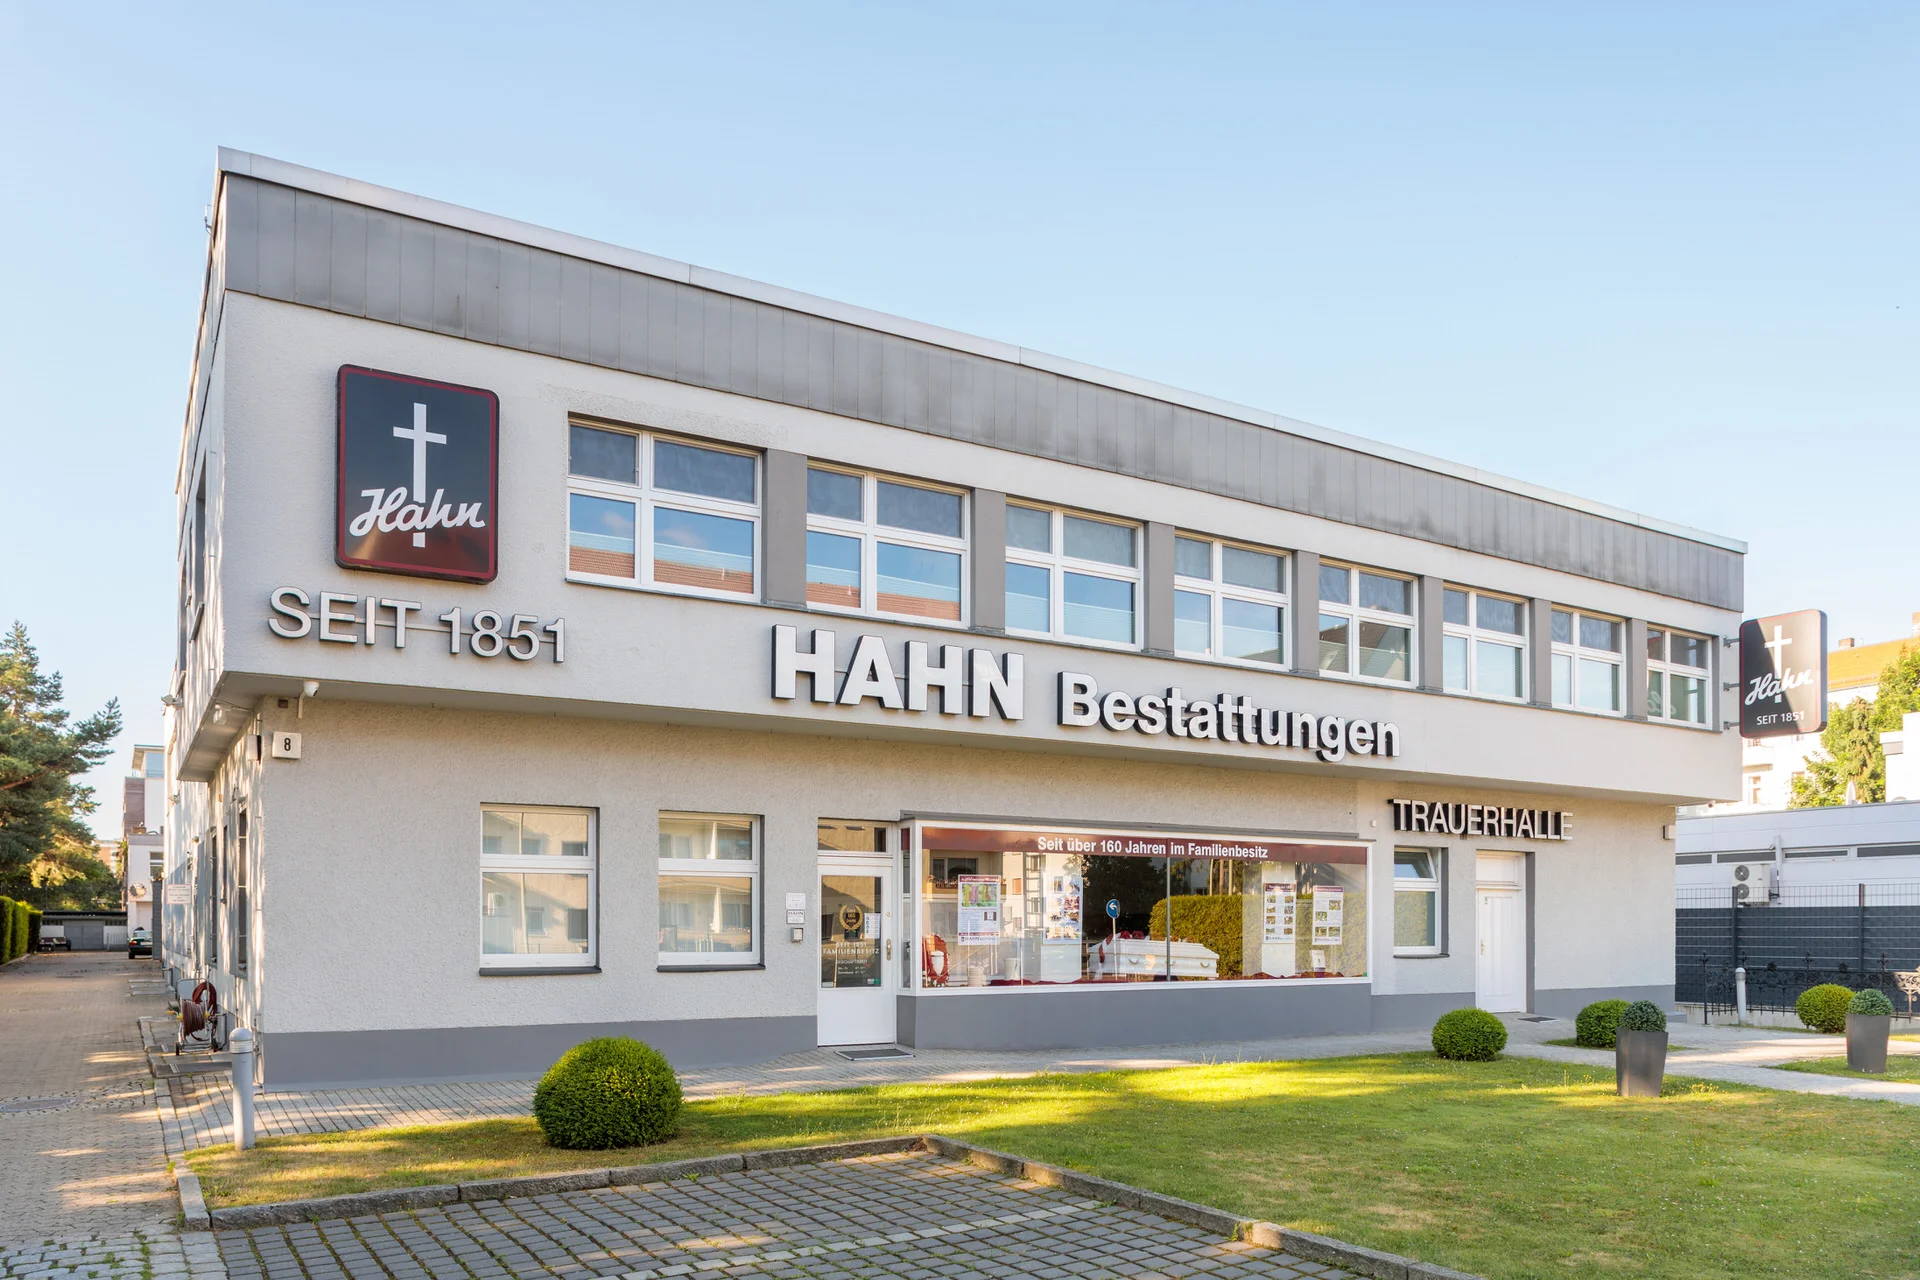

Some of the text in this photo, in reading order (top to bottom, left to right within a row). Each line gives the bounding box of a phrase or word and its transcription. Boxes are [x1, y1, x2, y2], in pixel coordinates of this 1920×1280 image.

[348, 486, 487, 537] Hahn
[268, 585, 566, 664] SEIT 1851
[770, 623, 1401, 763] HAHN Bestattungen
[1744, 667, 1814, 706] Hahn
[1756, 711, 1805, 726] SEIT 1851
[284, 737, 291, 752] 8
[1391, 798, 1574, 841] TRAUERHALLE
[1037, 835, 1268, 859] Seit über 160 Jahren im Familienbesitz
